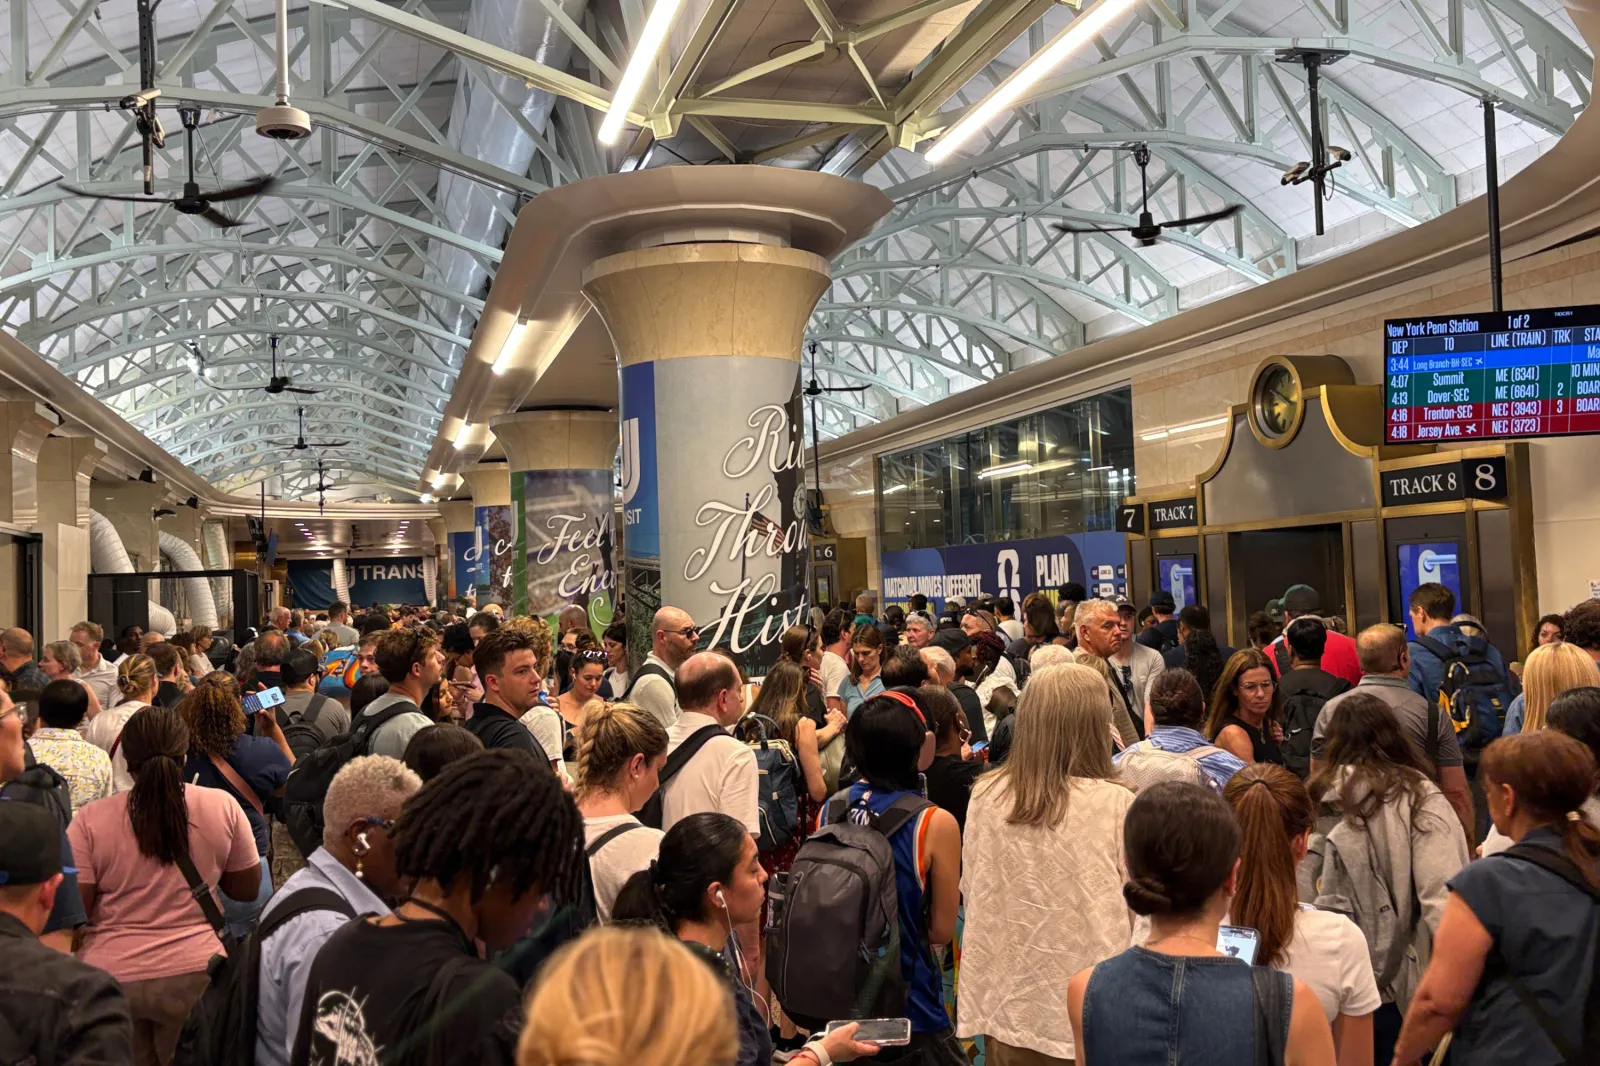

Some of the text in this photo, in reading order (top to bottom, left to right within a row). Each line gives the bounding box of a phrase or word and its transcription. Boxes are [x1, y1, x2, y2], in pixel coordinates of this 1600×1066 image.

[1387, 319, 1479, 337] New York Penn Station
[1508, 314, 1530, 329] 1 of 2
[1444, 337, 1455, 351] TO
[1491, 329, 1547, 348] LINE (TRAIN)
[1554, 329, 1571, 344] TRK
[1392, 340, 1408, 355] DEP
[1391, 358, 1409, 372] 3:44
[1413, 360, 1428, 370] Long
[1571, 363, 1580, 378] 10
[1391, 374, 1409, 388] 4:07
[1433, 371, 1464, 386] Summit
[1495, 365, 1540, 382] ME (6341)
[1495, 382, 1540, 400] ME (6641)
[1557, 382, 1564, 396] 2
[1576, 380, 1600, 395] BOAR
[1391, 391, 1408, 405] 4:13
[1427, 388, 1470, 404] Dover-SEC
[1491, 400, 1542, 417] NEC (3943)
[1556, 400, 1563, 413] 3
[1576, 397, 1600, 412] BOAR
[1391, 408, 1408, 422] 4:16
[1423, 405, 1473, 420] Trenton-SEC
[1391, 425, 1408, 439] 4:18
[1417, 423, 1462, 439] Jersey Ave.
[1491, 417, 1541, 434] NEC (3723)
[1389, 472, 1457, 496] TRACK 8
[1475, 463, 1496, 491] 8
[1123, 508, 1136, 528] 7
[1153, 505, 1194, 522] TRACK 7
[537, 512, 609, 564] Feel
[824, 545, 833, 558] 6
[1035, 553, 1070, 587] PLAN
[884, 574, 982, 597] MATCHDAY MOVES DIFFERENT
